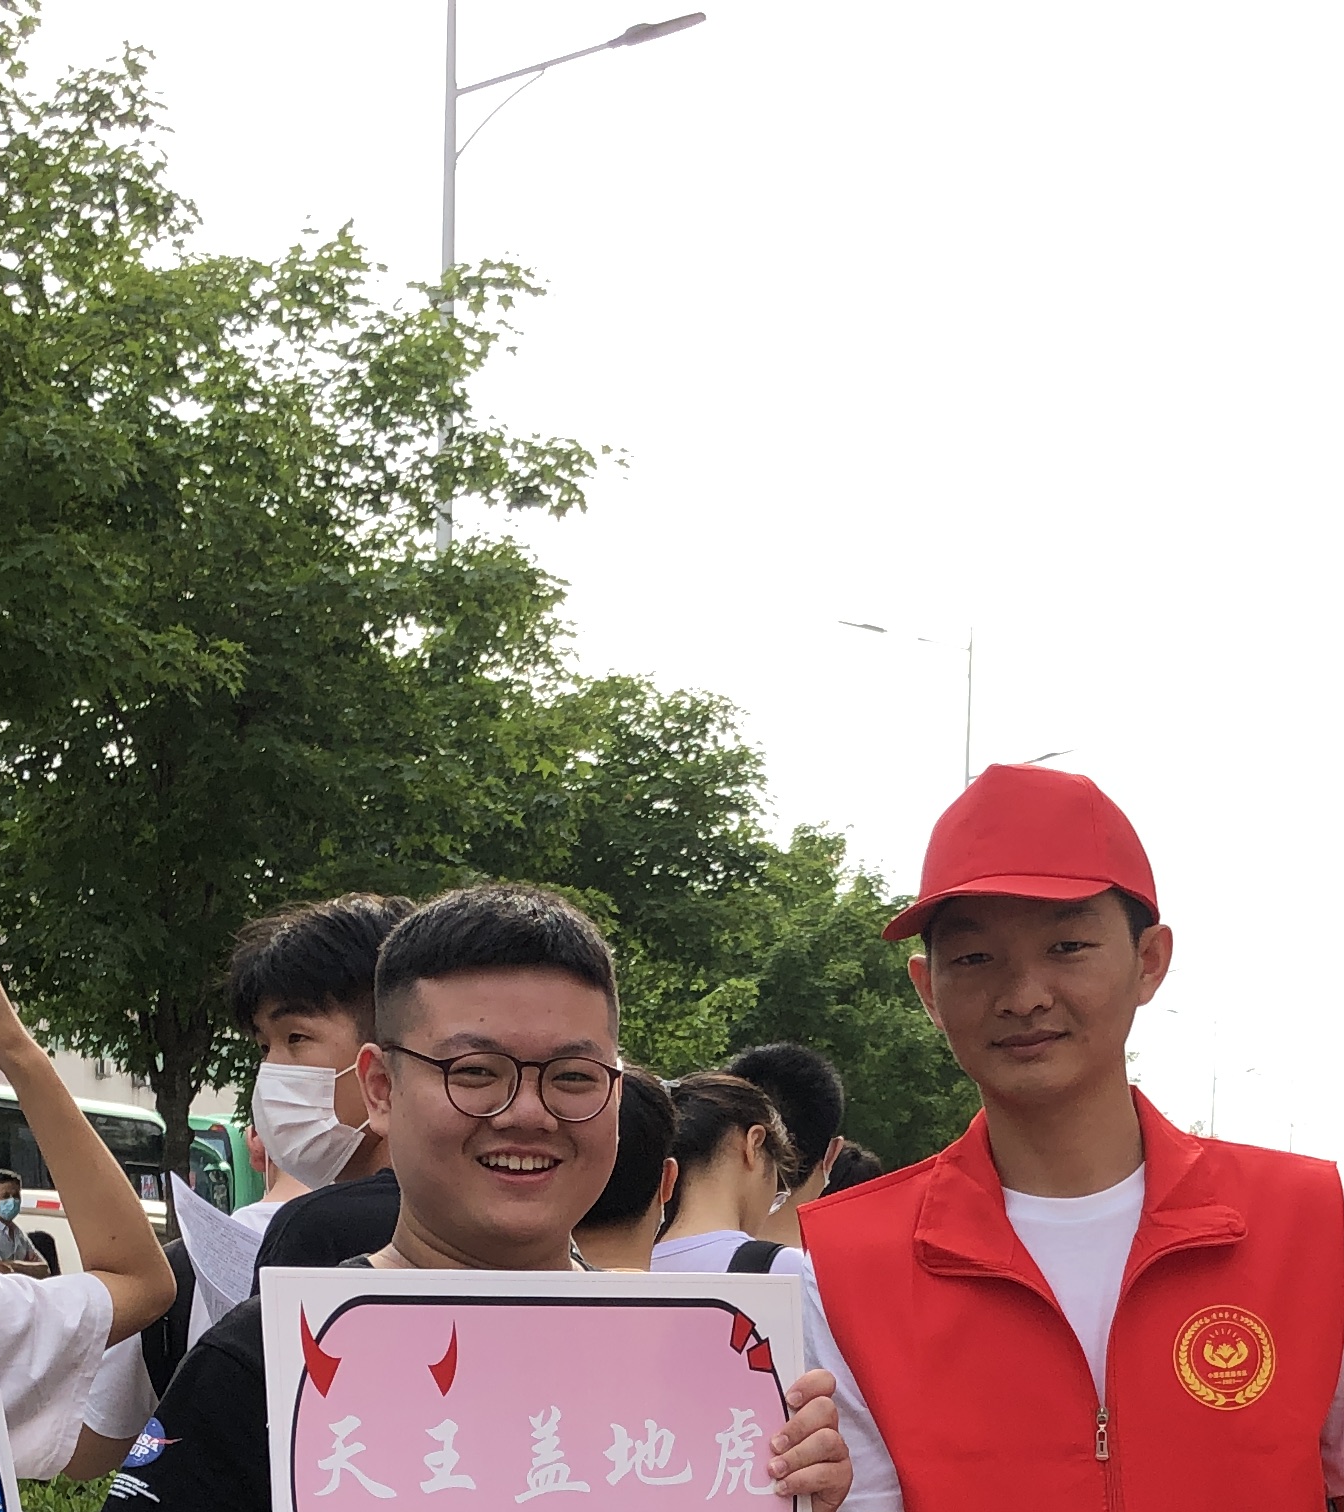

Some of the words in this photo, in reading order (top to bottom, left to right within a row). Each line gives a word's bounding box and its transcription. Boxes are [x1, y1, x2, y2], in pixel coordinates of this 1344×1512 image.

[313, 1405, 776, 1504] 天王盖地虎
